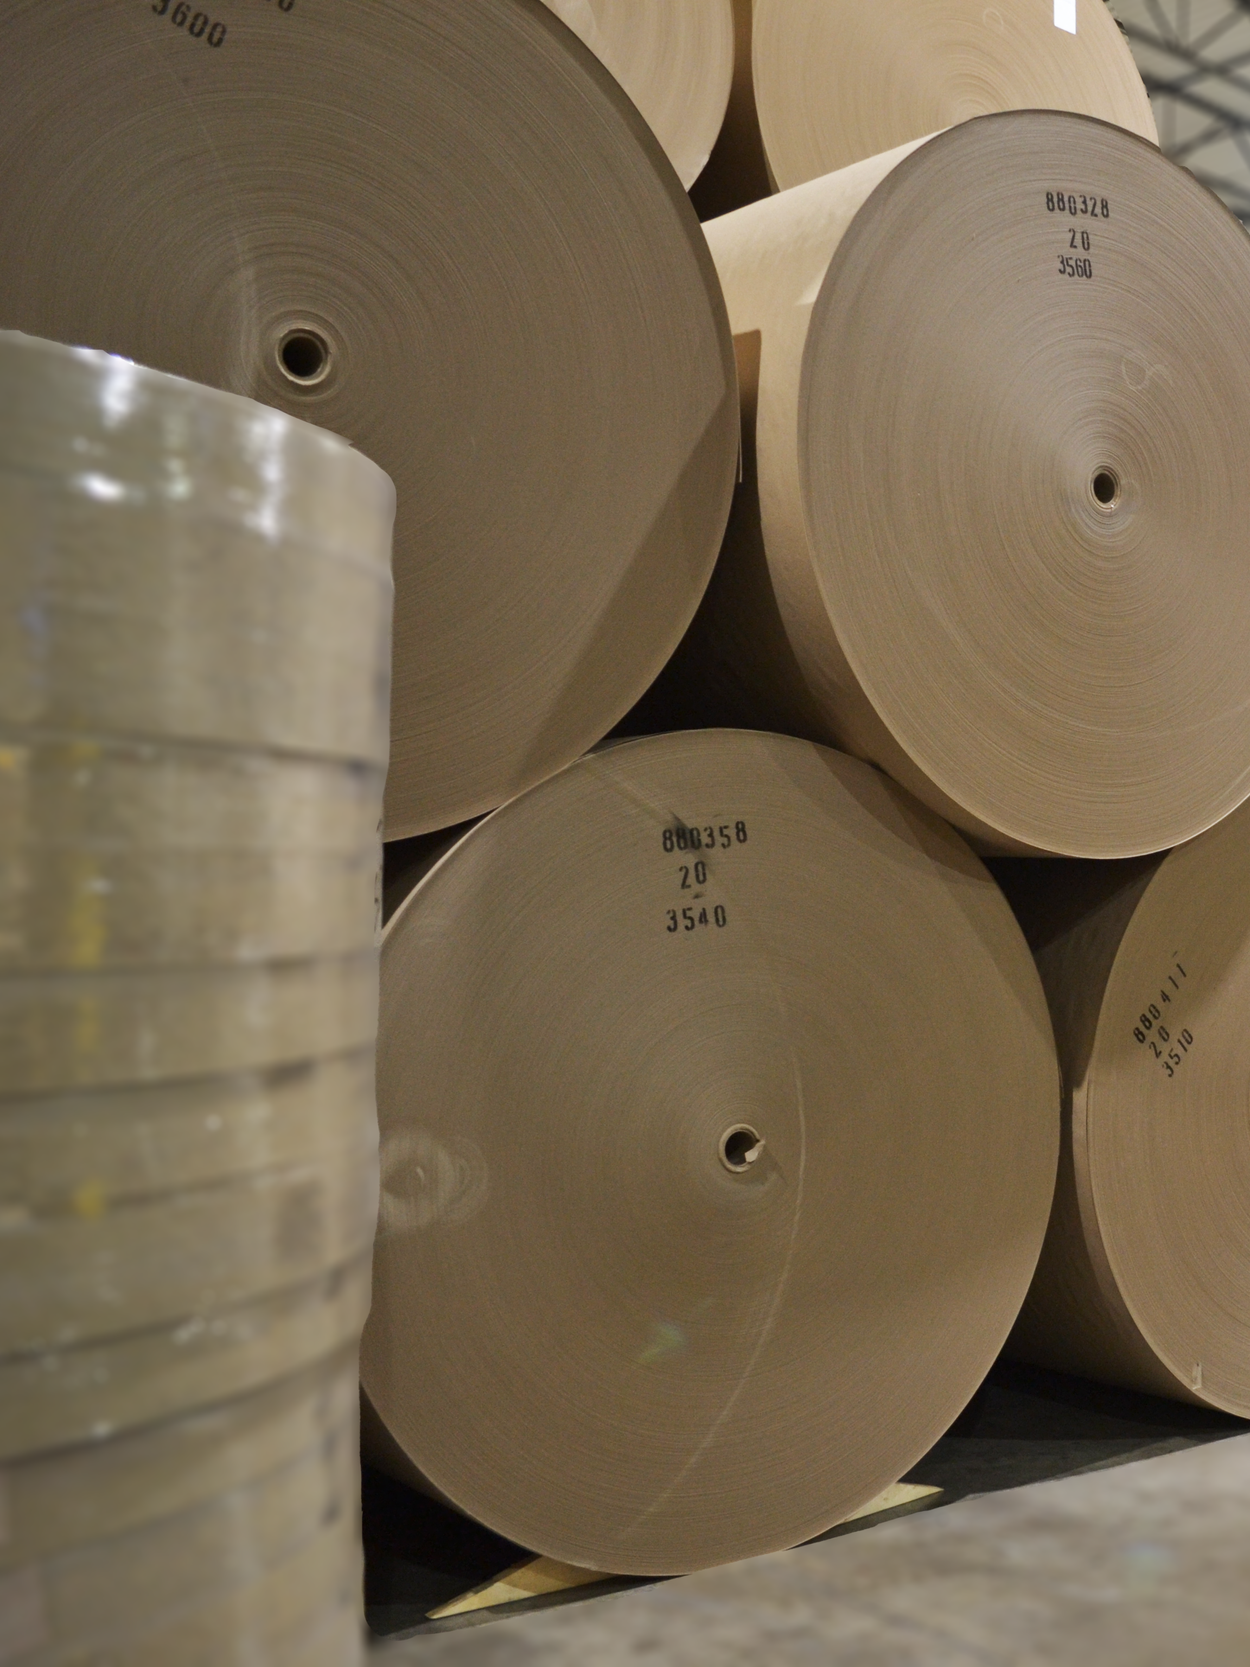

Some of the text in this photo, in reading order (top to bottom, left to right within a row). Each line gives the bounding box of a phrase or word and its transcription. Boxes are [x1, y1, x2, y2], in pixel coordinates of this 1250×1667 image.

[152, 0, 227, 48] 3600
[1046, 191, 1110, 219] 880328
[1068, 228, 1091, 251] 20
[1057, 254, 1093, 279] 3560
[662, 820, 748, 853] 880358
[678, 860, 707, 890] 20
[666, 904, 727, 933] 3540
[1133, 963, 1187, 1044] 880411
[1149, 1025, 1170, 1059] 20
[1162, 1028, 1194, 1078] 3510
